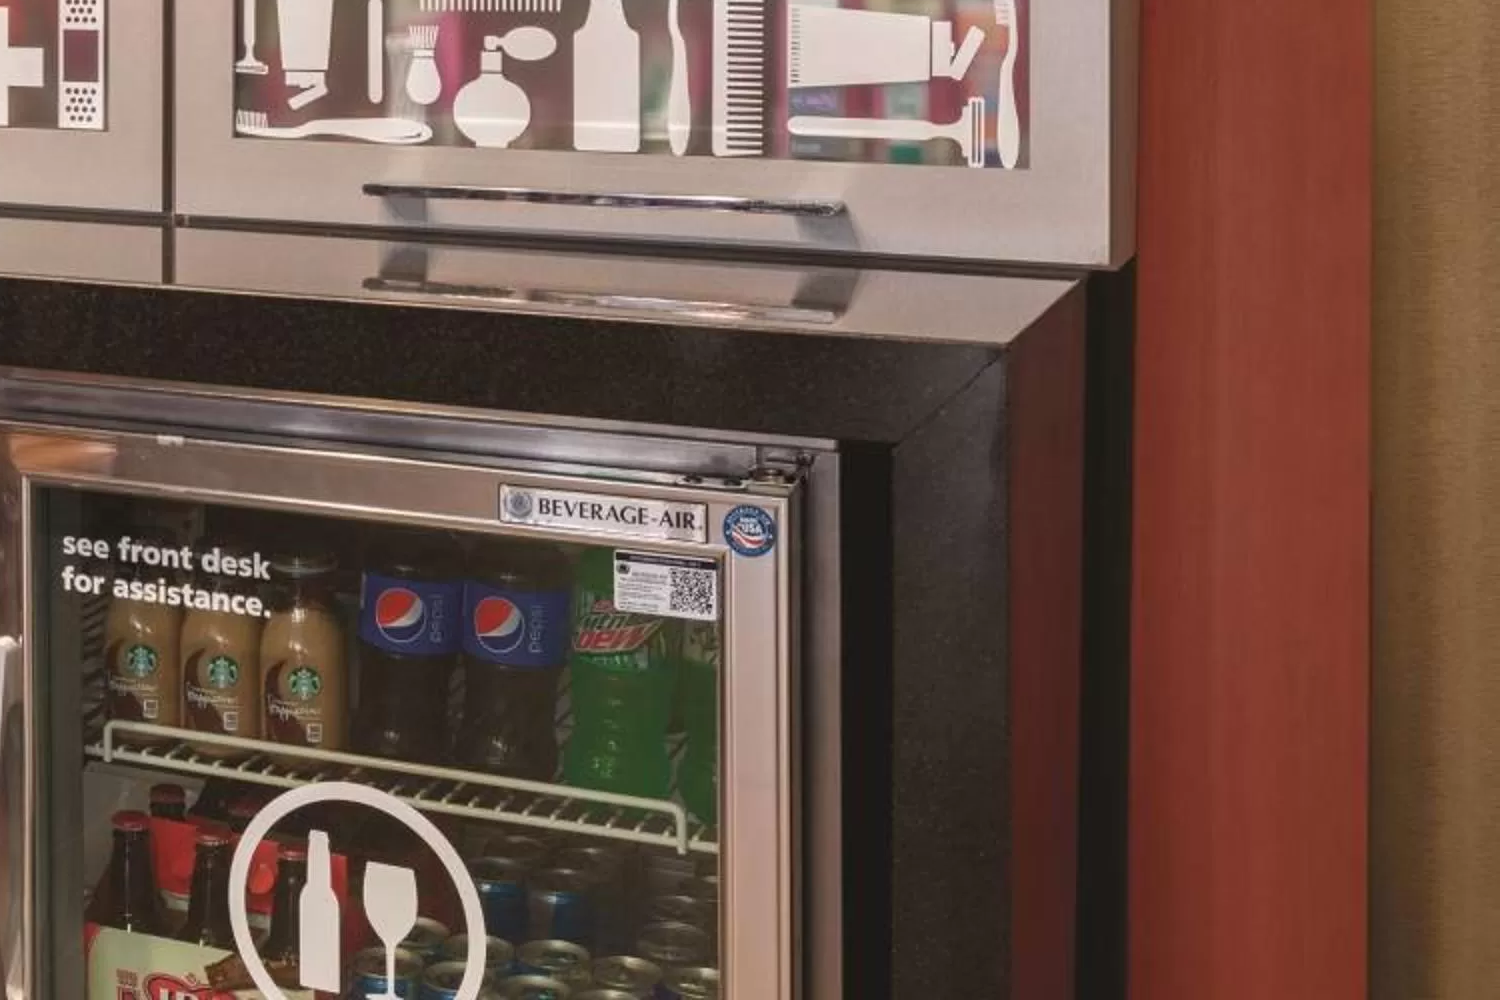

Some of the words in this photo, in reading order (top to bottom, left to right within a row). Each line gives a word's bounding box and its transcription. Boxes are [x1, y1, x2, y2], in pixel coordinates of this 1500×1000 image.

[539, 498, 696, 531] BEVERAGE-AIR
[63, 536, 109, 558] see
[117, 536, 193, 570] front
[202, 548, 271, 580] desk
[62, 566, 105, 594] for
[113, 578, 272, 618] assistance.
